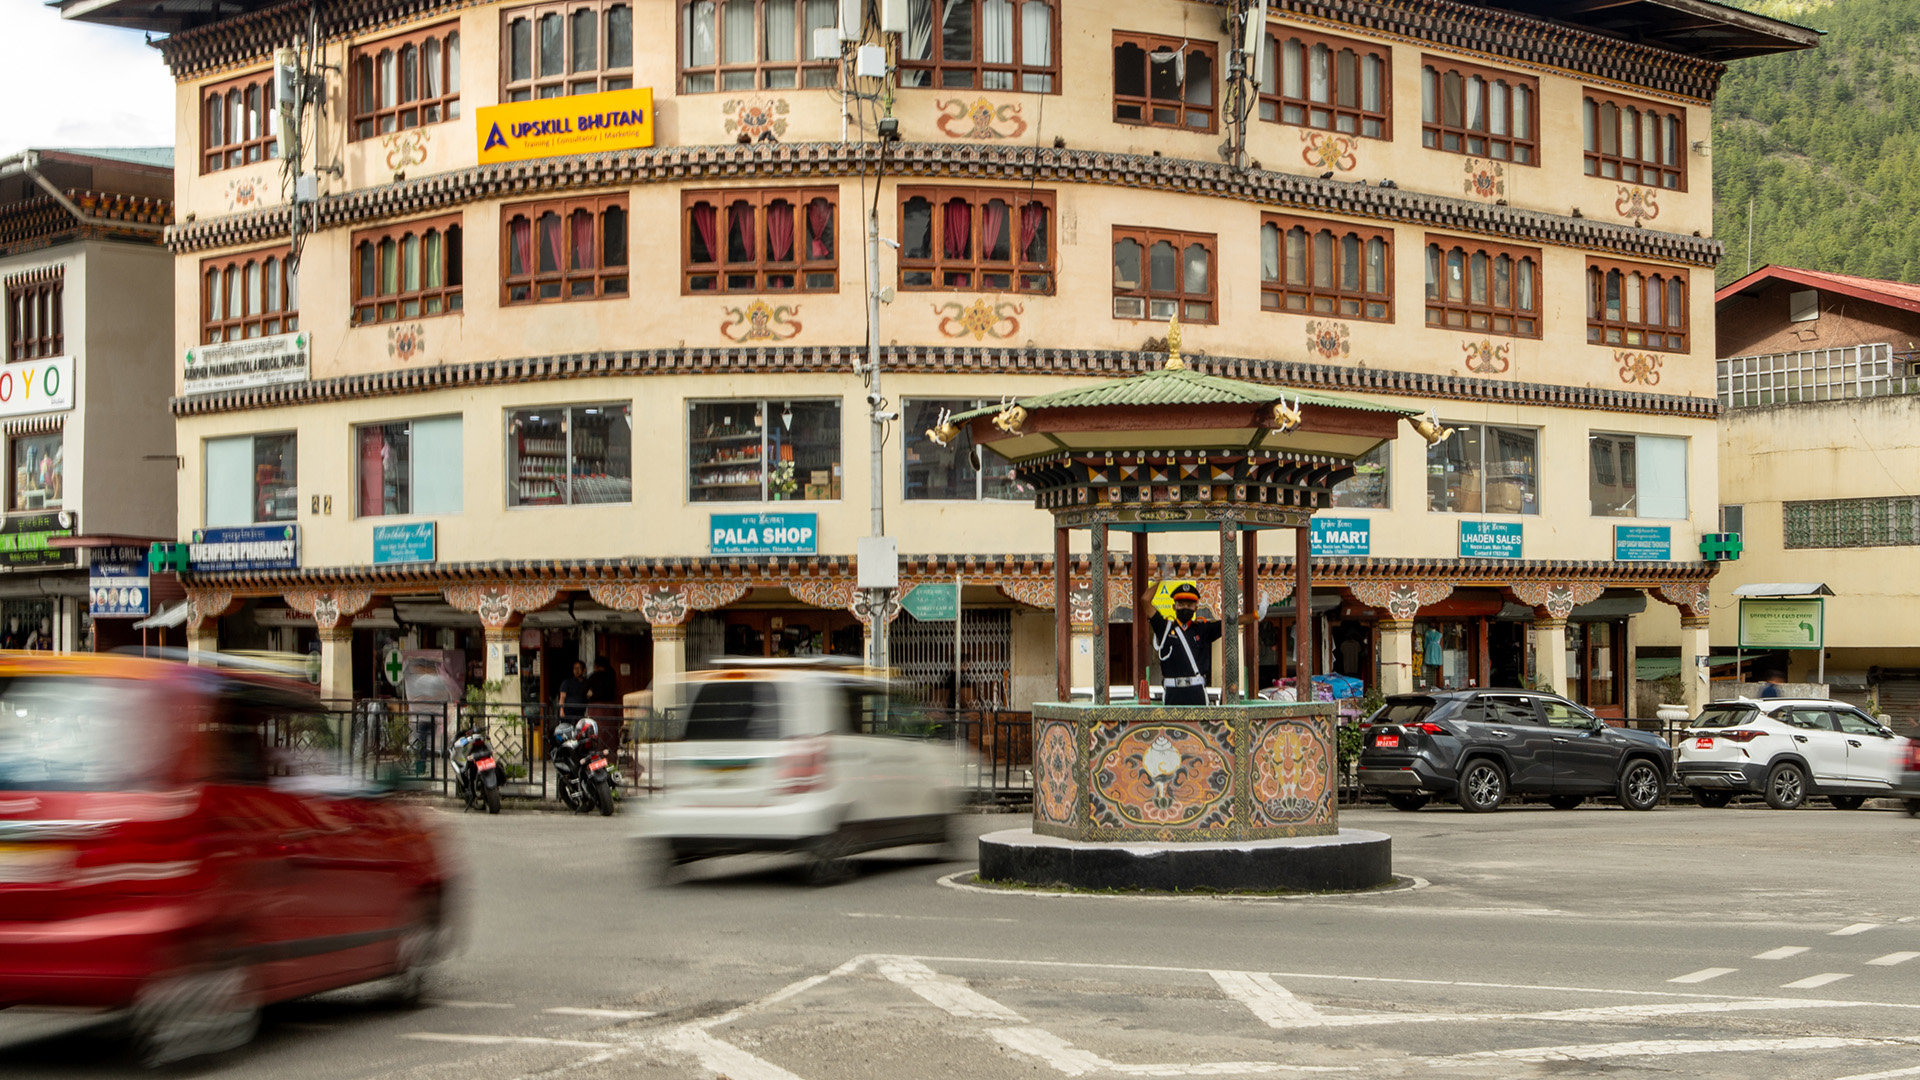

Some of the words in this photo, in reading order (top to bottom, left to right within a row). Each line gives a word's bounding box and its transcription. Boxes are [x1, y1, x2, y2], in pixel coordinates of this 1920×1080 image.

[511, 117, 572, 138] UPSKILL
[577, 109, 643, 131] BHUTAN
[524, 139, 550, 148] Training
[556, 135, 597, 145] Consultancy
[604, 130, 640, 140] Marketing
[209, 360, 253, 377] PHARMACEUTICAL
[258, 357, 280, 371] MEDICAL
[281, 353, 305, 369] SUPPLIES
[0, 367, 60, 402] OYO
[375, 526, 410, 543] Birthday
[411, 522, 432, 541] Shop
[714, 528, 759, 545] PALA
[762, 527, 812, 544] SHOP
[1326, 531, 1368, 544] MART
[1462, 533, 1495, 544] LHADEN
[1496, 534, 1522, 545] SALES
[119, 546, 143, 561] GRILL
[189, 543, 239, 563] KUENPHEN
[240, 540, 296, 561] PHARMACY
